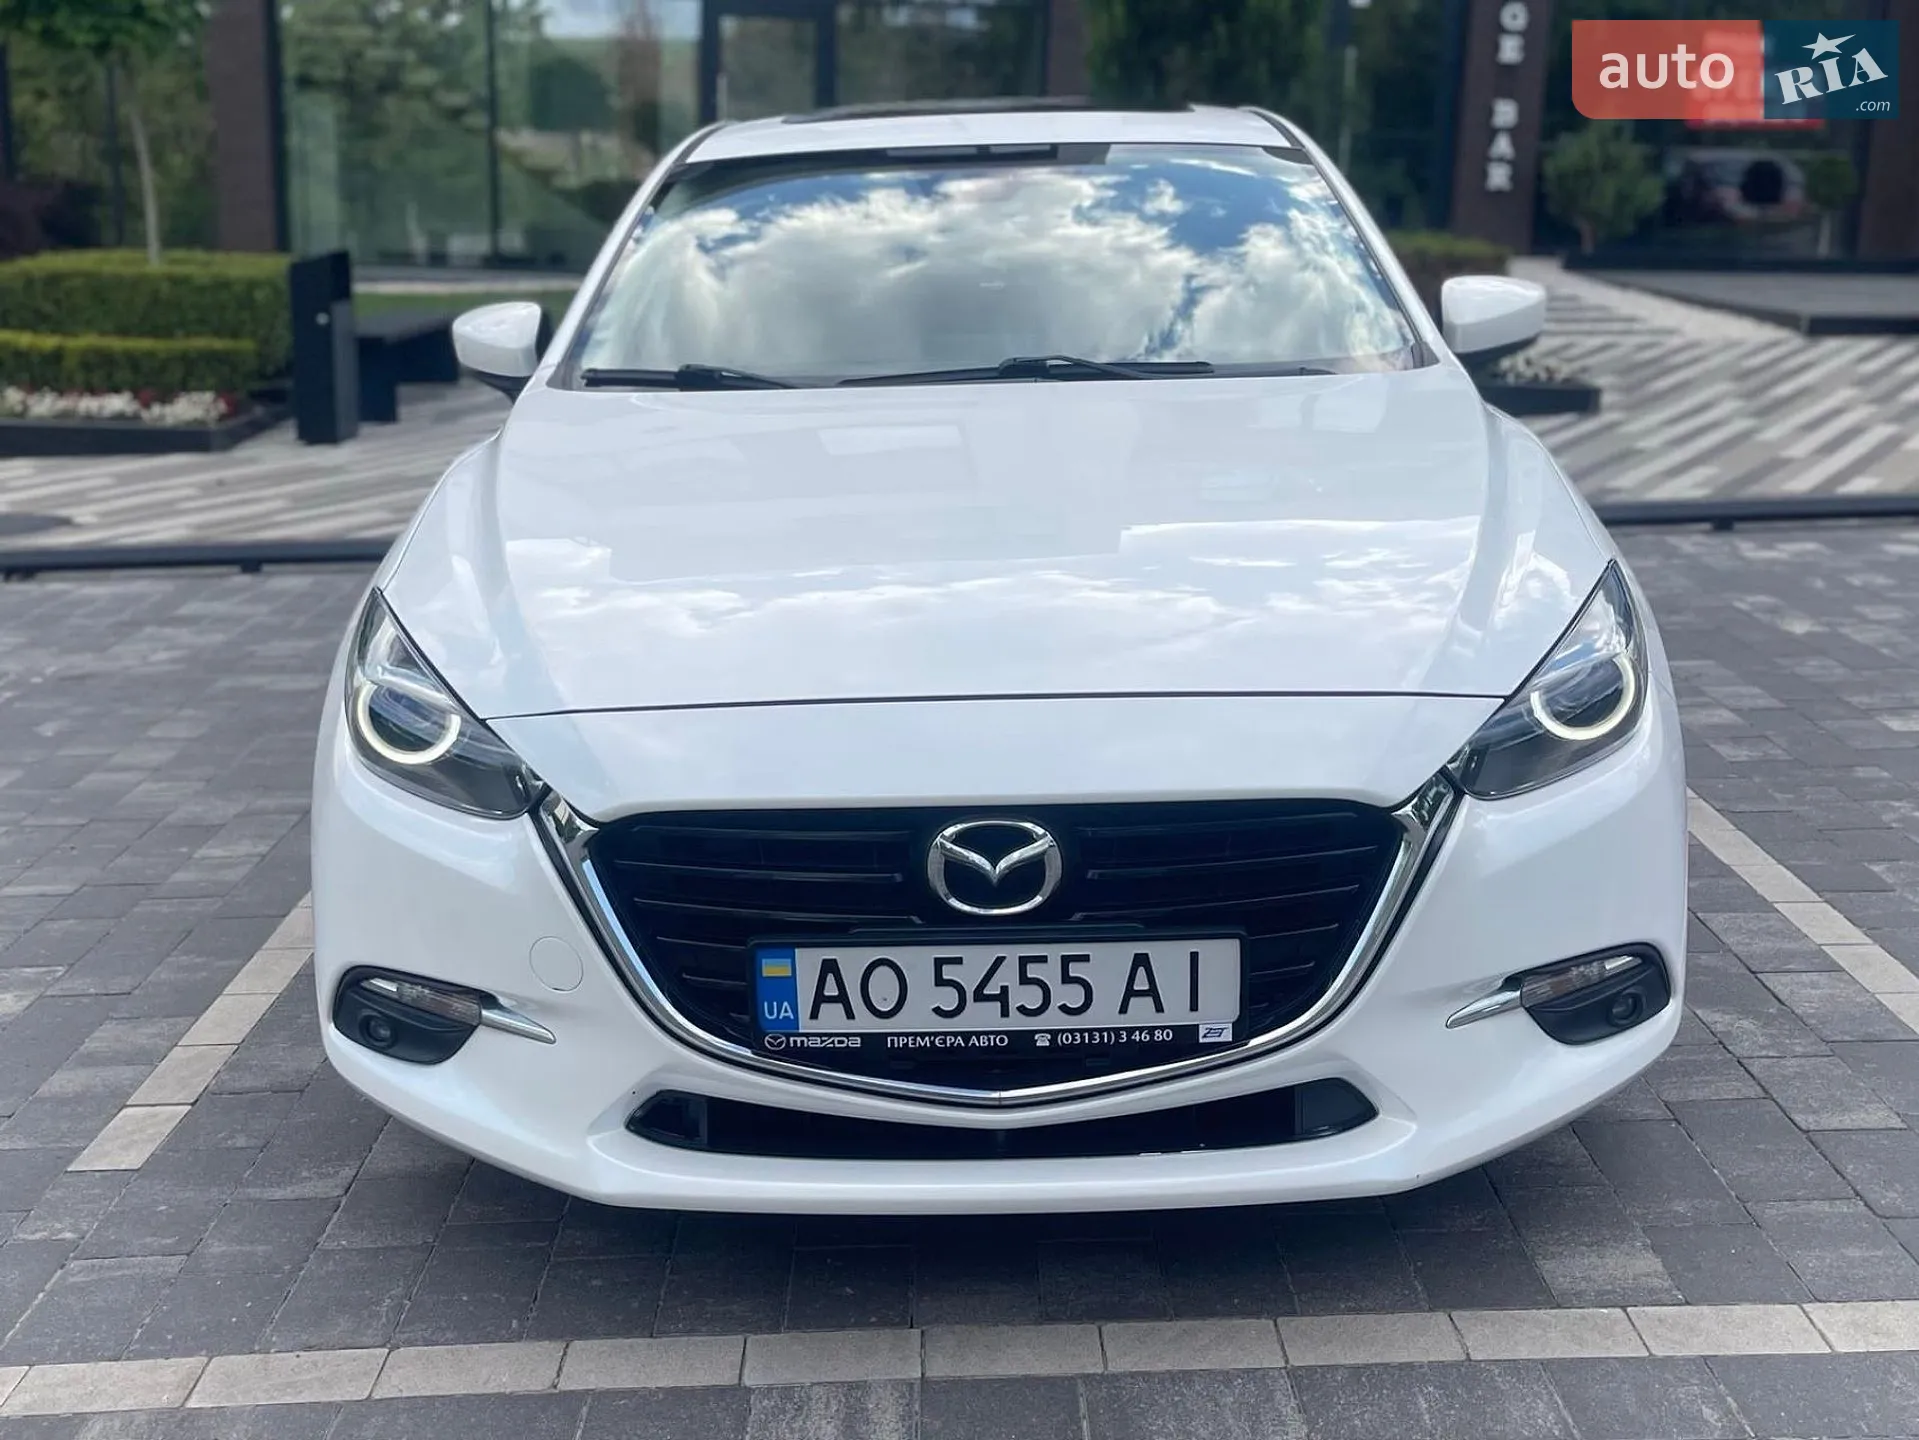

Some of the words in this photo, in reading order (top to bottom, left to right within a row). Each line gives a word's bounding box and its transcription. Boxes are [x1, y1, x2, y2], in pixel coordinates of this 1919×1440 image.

[808, 957, 909, 1020] AO
[931, 954, 1094, 1019] 5455
[764, 1001, 794, 1020] UA
[968, 1034, 1009, 1047] АВТО
[1057, 1031, 1116, 1046] (03131)
[1118, 1031, 1128, 1043] 3
[1131, 1030, 1150, 1042] 46
[1153, 1029, 1174, 1042] 80
